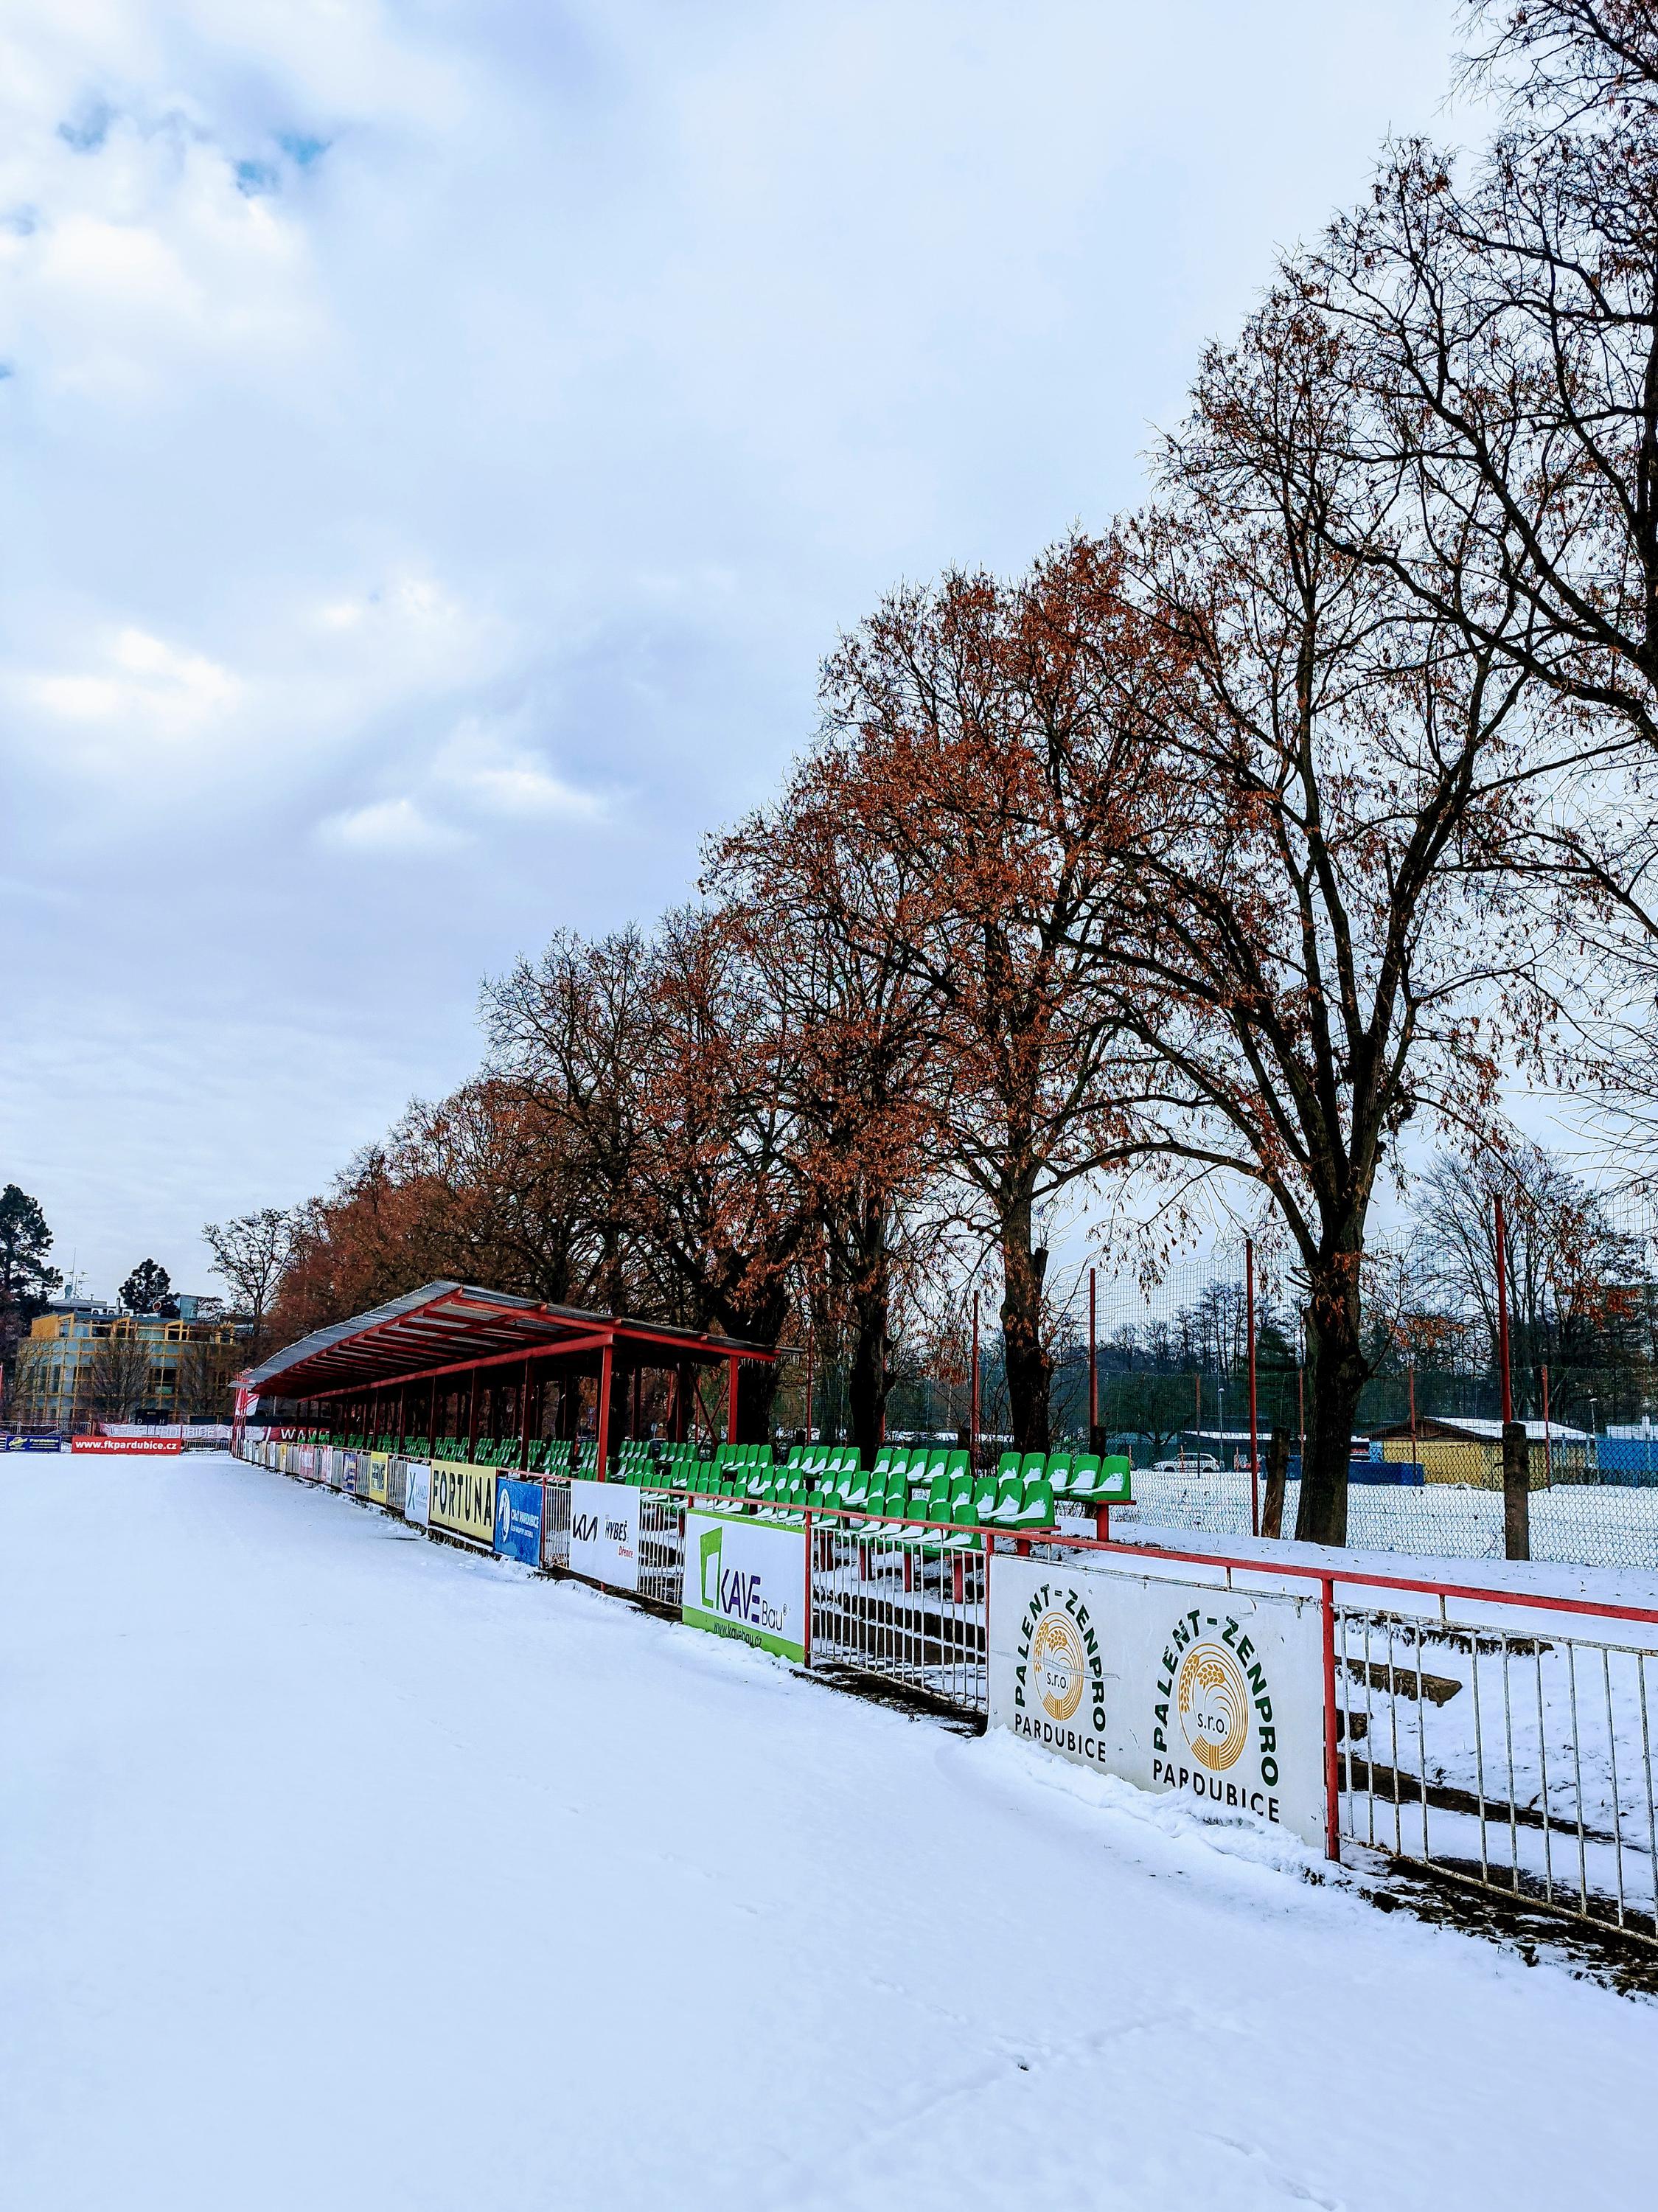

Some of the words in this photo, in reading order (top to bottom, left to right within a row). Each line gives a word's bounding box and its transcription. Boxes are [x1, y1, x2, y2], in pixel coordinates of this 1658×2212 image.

[75, 1440, 177, 1450] www.fkpardubice.cz
[433, 1470, 492, 1527] FORTUNA
[605, 1520, 627, 1543] HYBEŠ
[721, 1568, 760, 1624] KAVE
[1046, 1671, 1069, 1691] s.r.o.
[1014, 1713, 1107, 1764] PARDUBICE
[1197, 1712, 1228, 1736] s.r.o.
[1153, 1758, 1281, 1824] PARDUBICE
